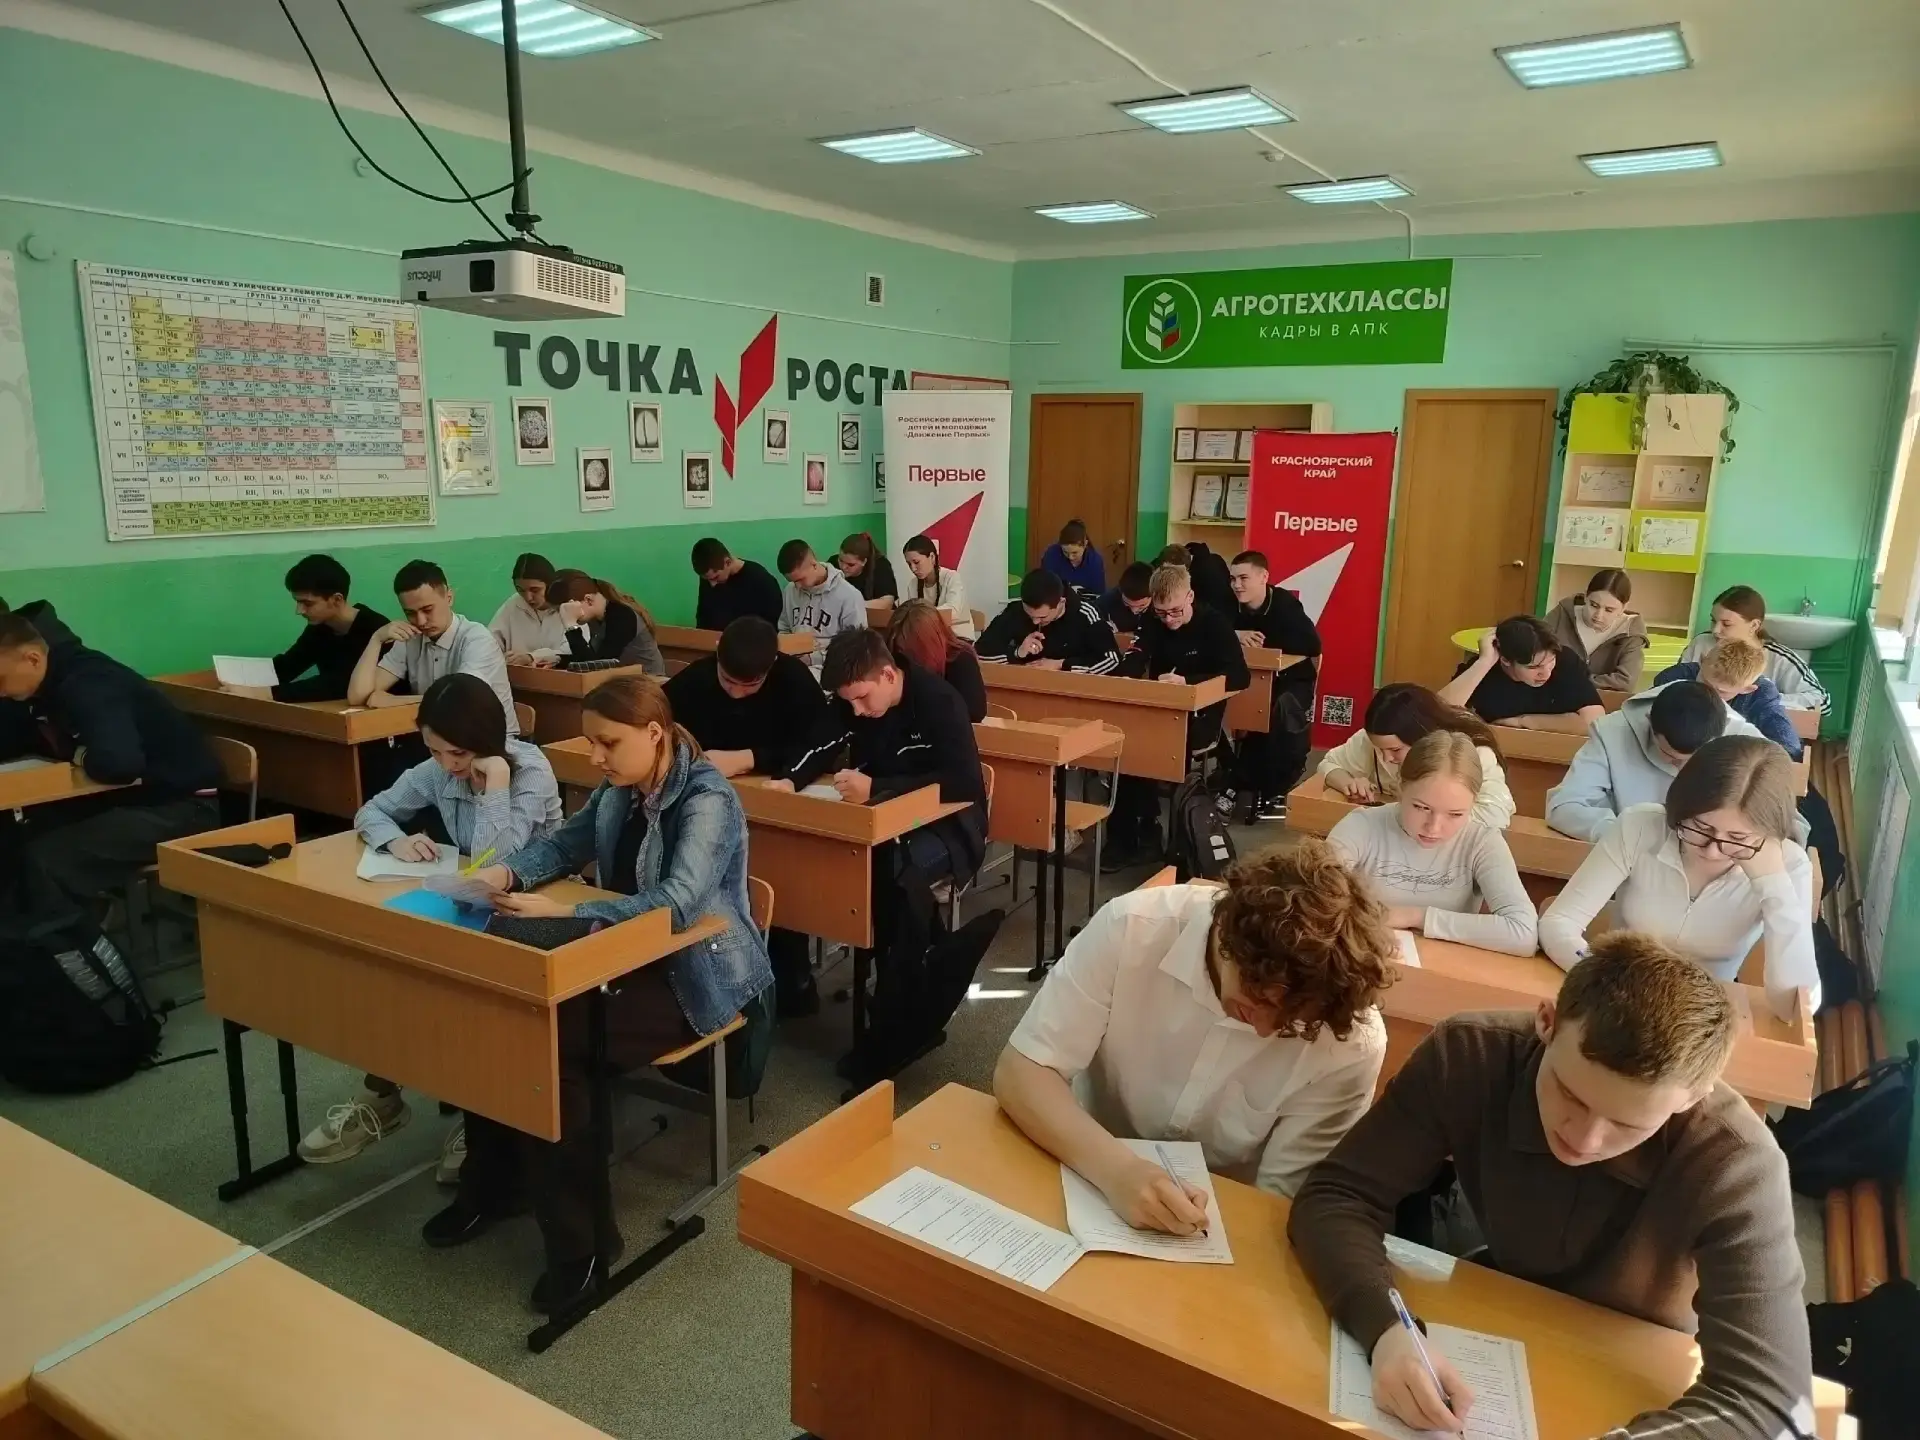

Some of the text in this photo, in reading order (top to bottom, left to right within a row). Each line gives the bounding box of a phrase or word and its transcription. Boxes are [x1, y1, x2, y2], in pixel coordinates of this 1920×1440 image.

[106, 267, 188, 282] Периодическая
[192, 277, 230, 286] система
[232, 281, 287, 292] химических
[290, 288, 334, 298] элементов
[1211, 286, 1447, 318] АГРОТЕХКЛАССЫ
[1259, 322, 1389, 339] КАДРЫ В АПК
[494, 330, 703, 396] ТОЧКА
[787, 358, 908, 407] РОСТА
[1271, 455, 1373, 467] КРАСНОЯРСКИЙ
[1303, 467, 1337, 479] КРАЙ
[908, 465, 986, 487] Первые
[1274, 511, 1358, 536] Первые
[792, 605, 832, 632] GAP
